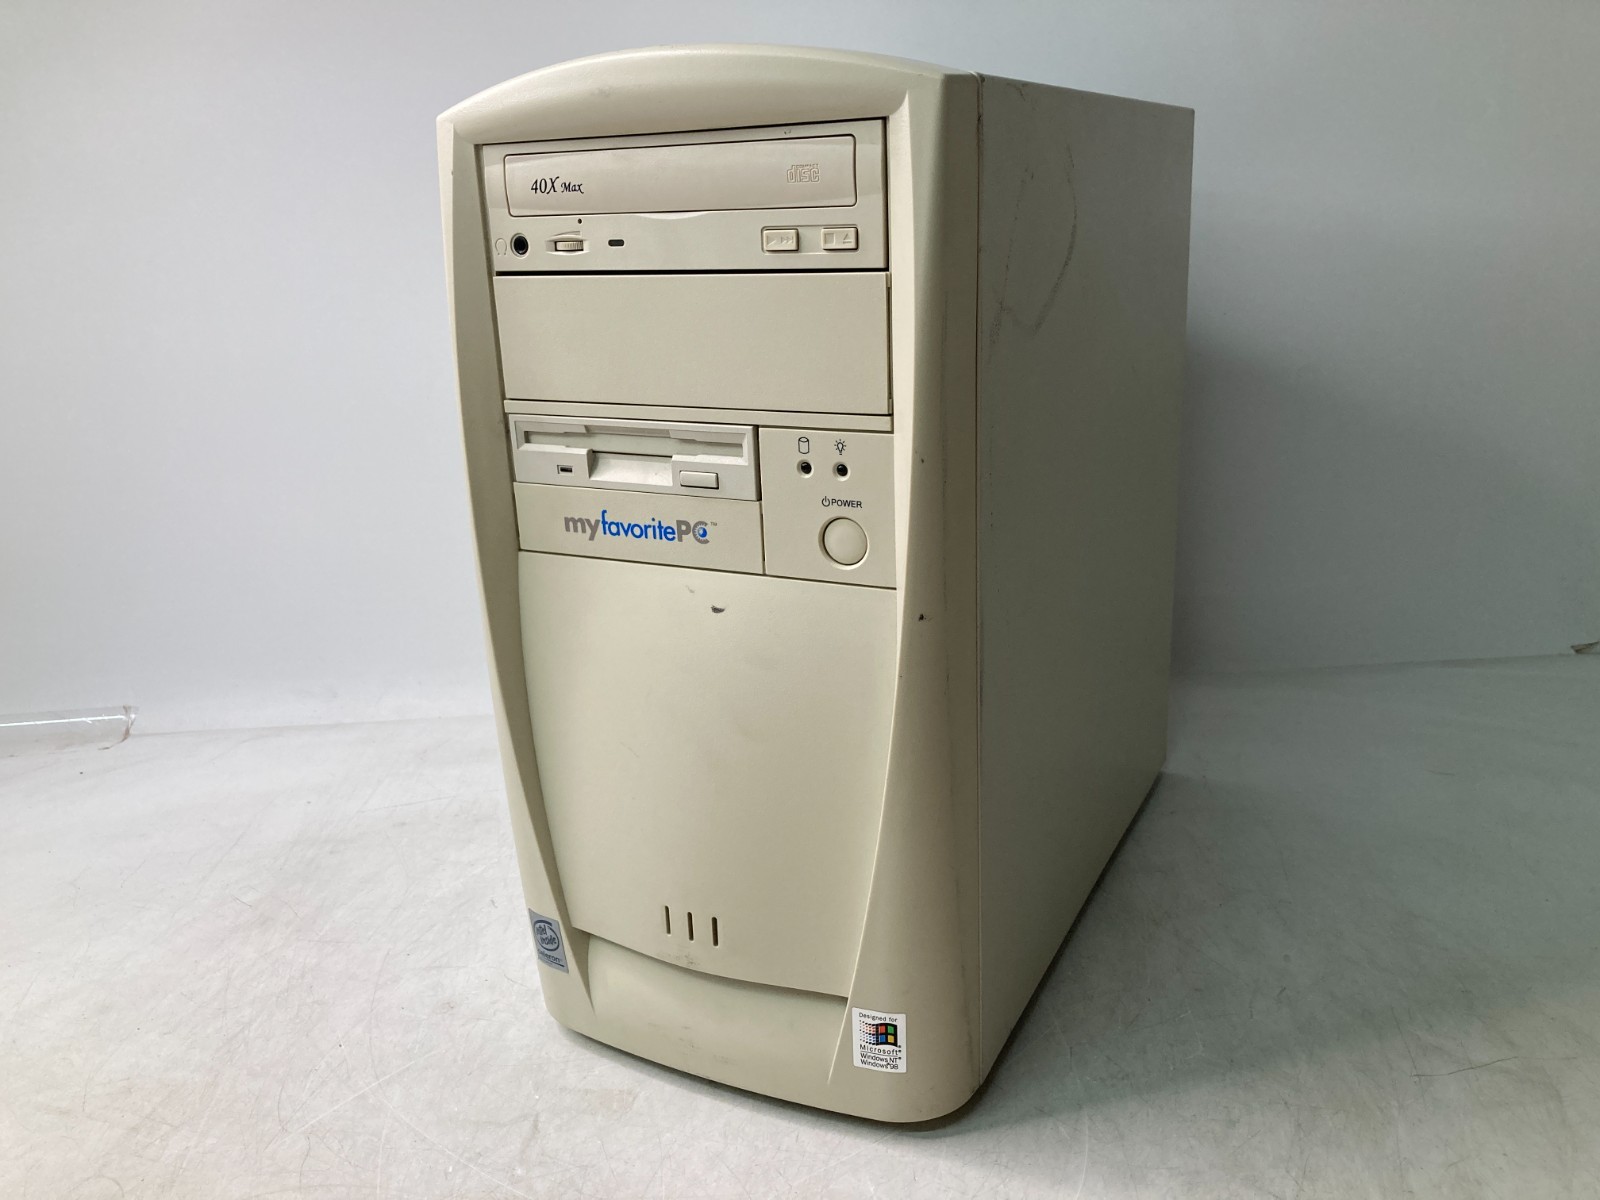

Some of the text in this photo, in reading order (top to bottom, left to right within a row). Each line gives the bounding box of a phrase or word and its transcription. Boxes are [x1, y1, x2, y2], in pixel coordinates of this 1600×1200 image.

[531, 176, 584, 194] 40X Max
[831, 498, 863, 509] POWER
[859, 1012, 887, 1021] Designed
[859, 1044, 898, 1056] Microsoft
[860, 1053, 889, 1062] Windows
[860, 1059, 889, 1069] Windows
